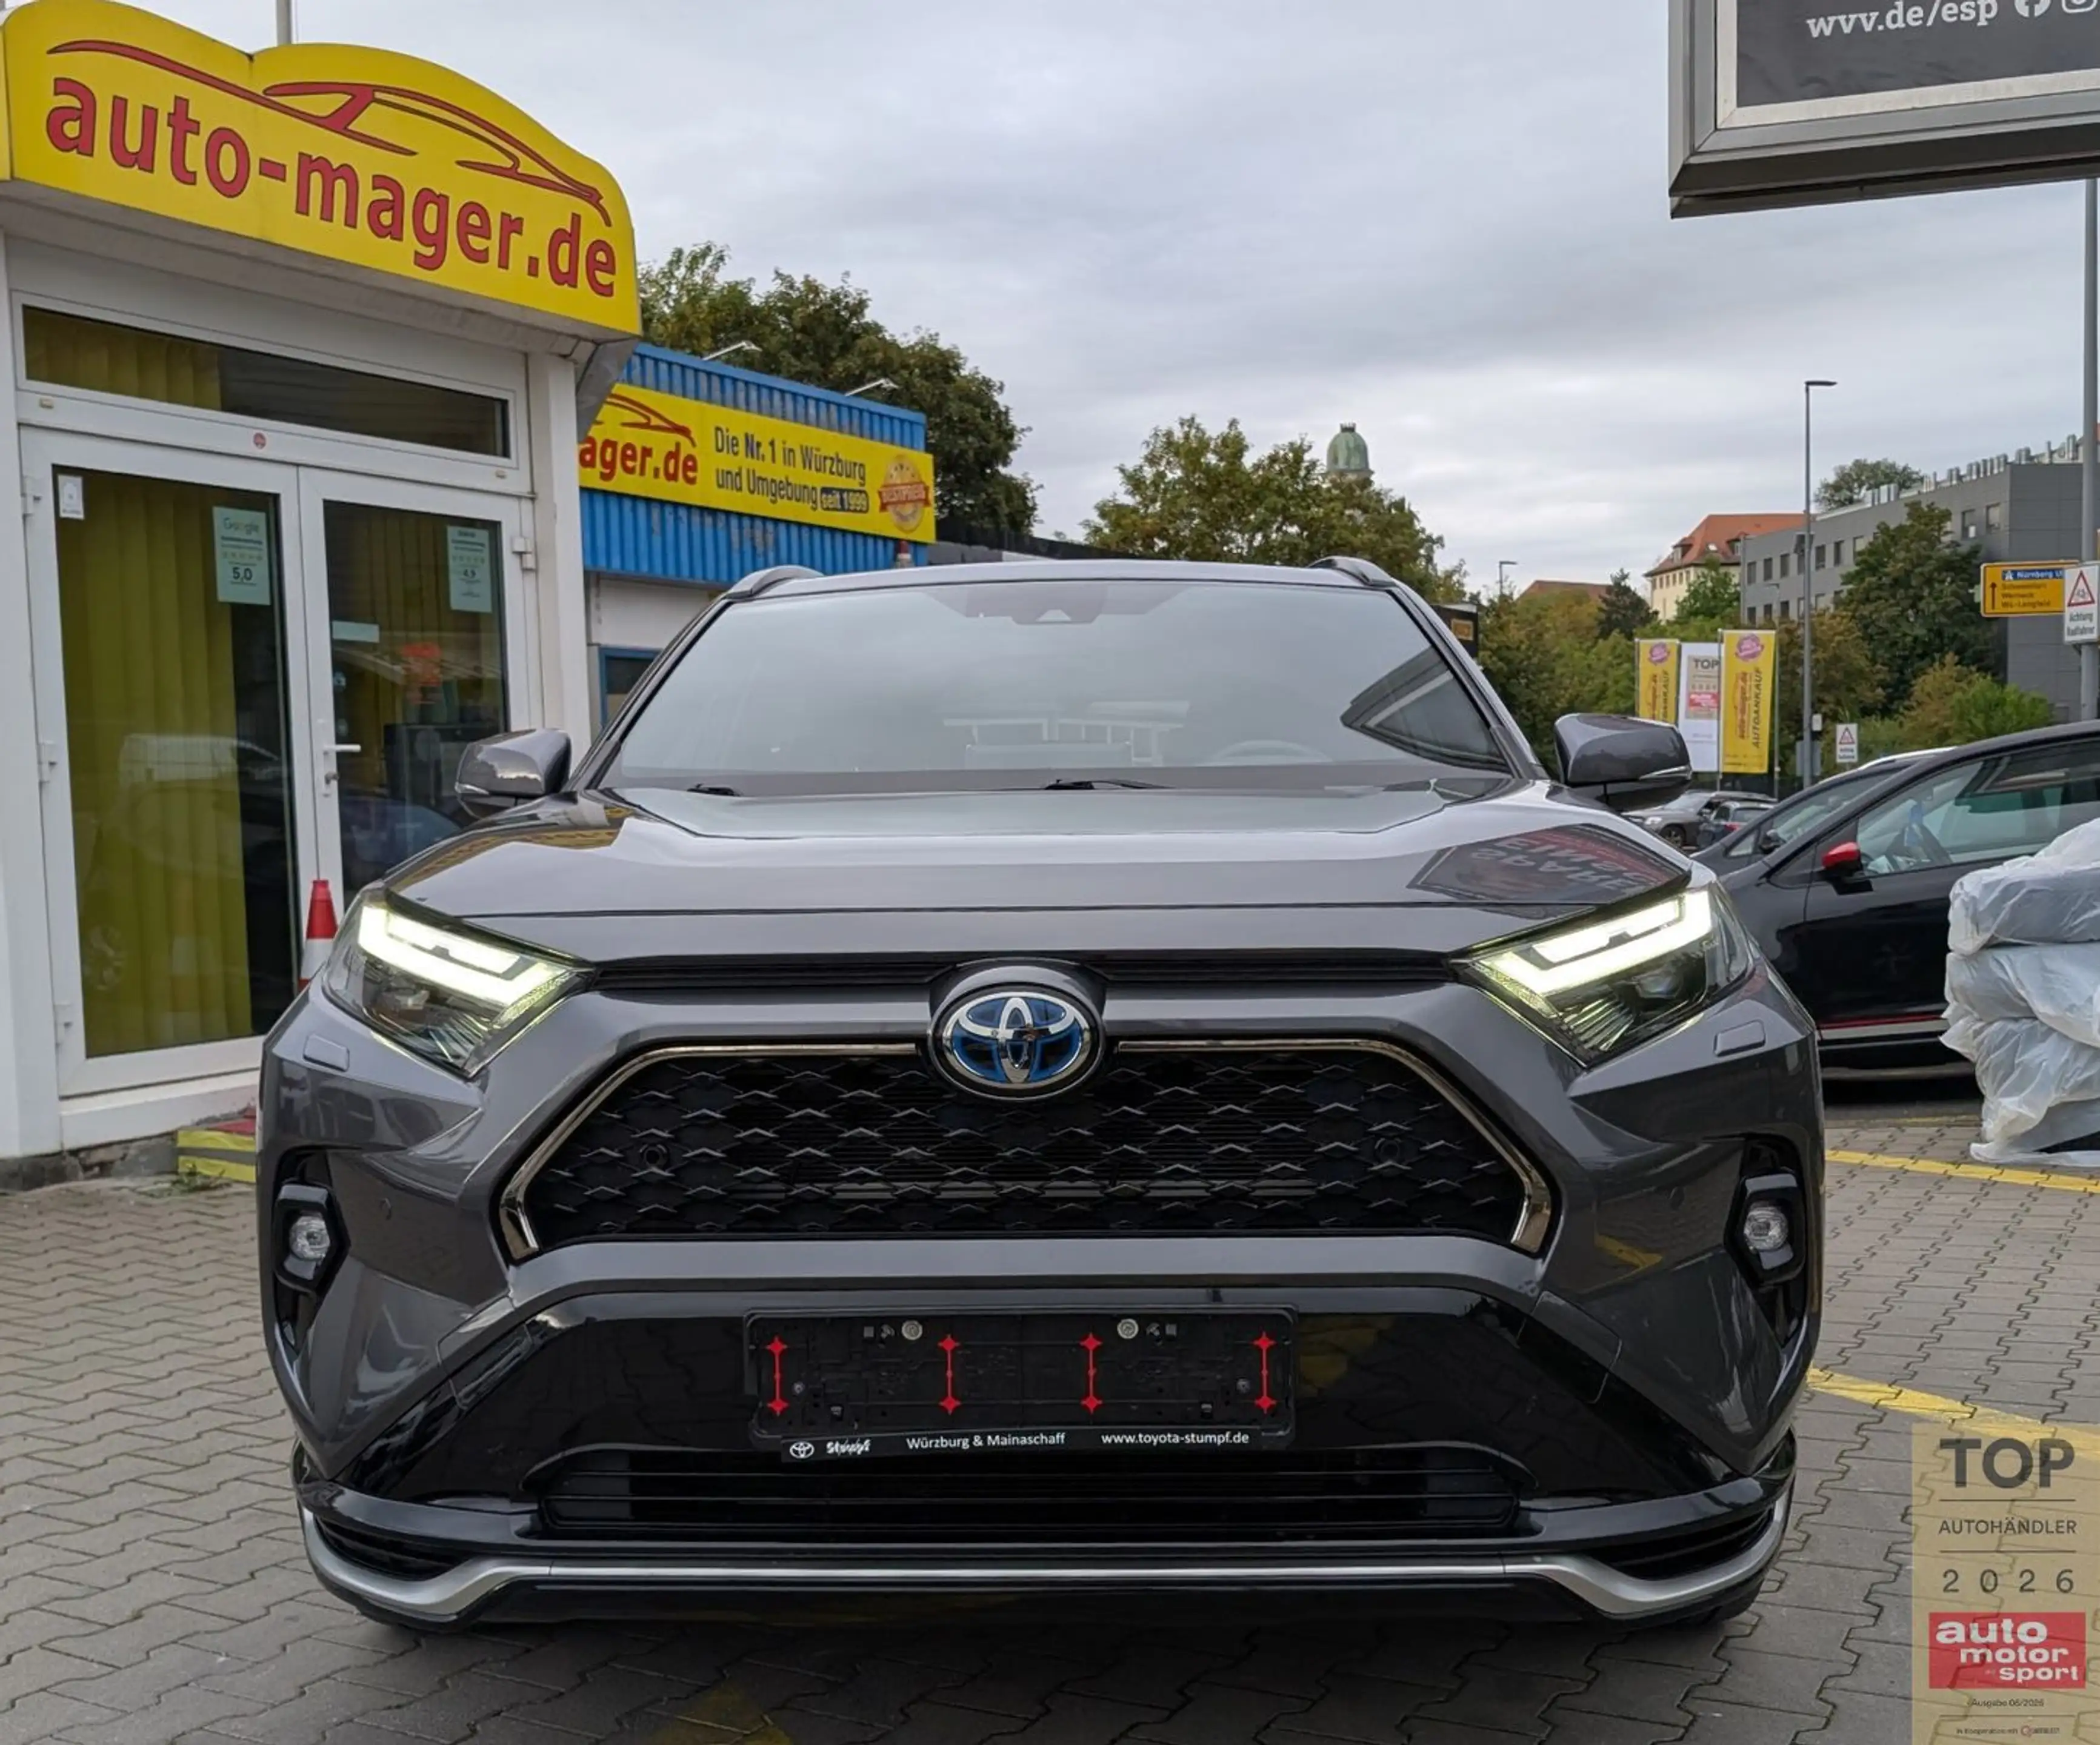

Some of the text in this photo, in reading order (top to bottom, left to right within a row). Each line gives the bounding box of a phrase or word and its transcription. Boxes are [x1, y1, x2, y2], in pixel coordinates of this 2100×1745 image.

[1806, 0, 1998, 38] wvv.de/esp
[46, 77, 616, 297] auto-mager.de
[579, 436, 699, 485] ager.de
[715, 426, 866, 487] Die Nr. 1 in Würzburg
[716, 466, 742, 493] und
[747, 467, 818, 511] Umgebung
[822, 490, 841, 509] seit
[1693, 657, 1719, 670] TOP
[906, 1437, 970, 1450] Würzburg
[972, 1434, 984, 1447] &
[987, 1432, 1066, 1446] Mainaschaff
[1101, 1432, 1249, 1446] www.toyota-stumpf.de
